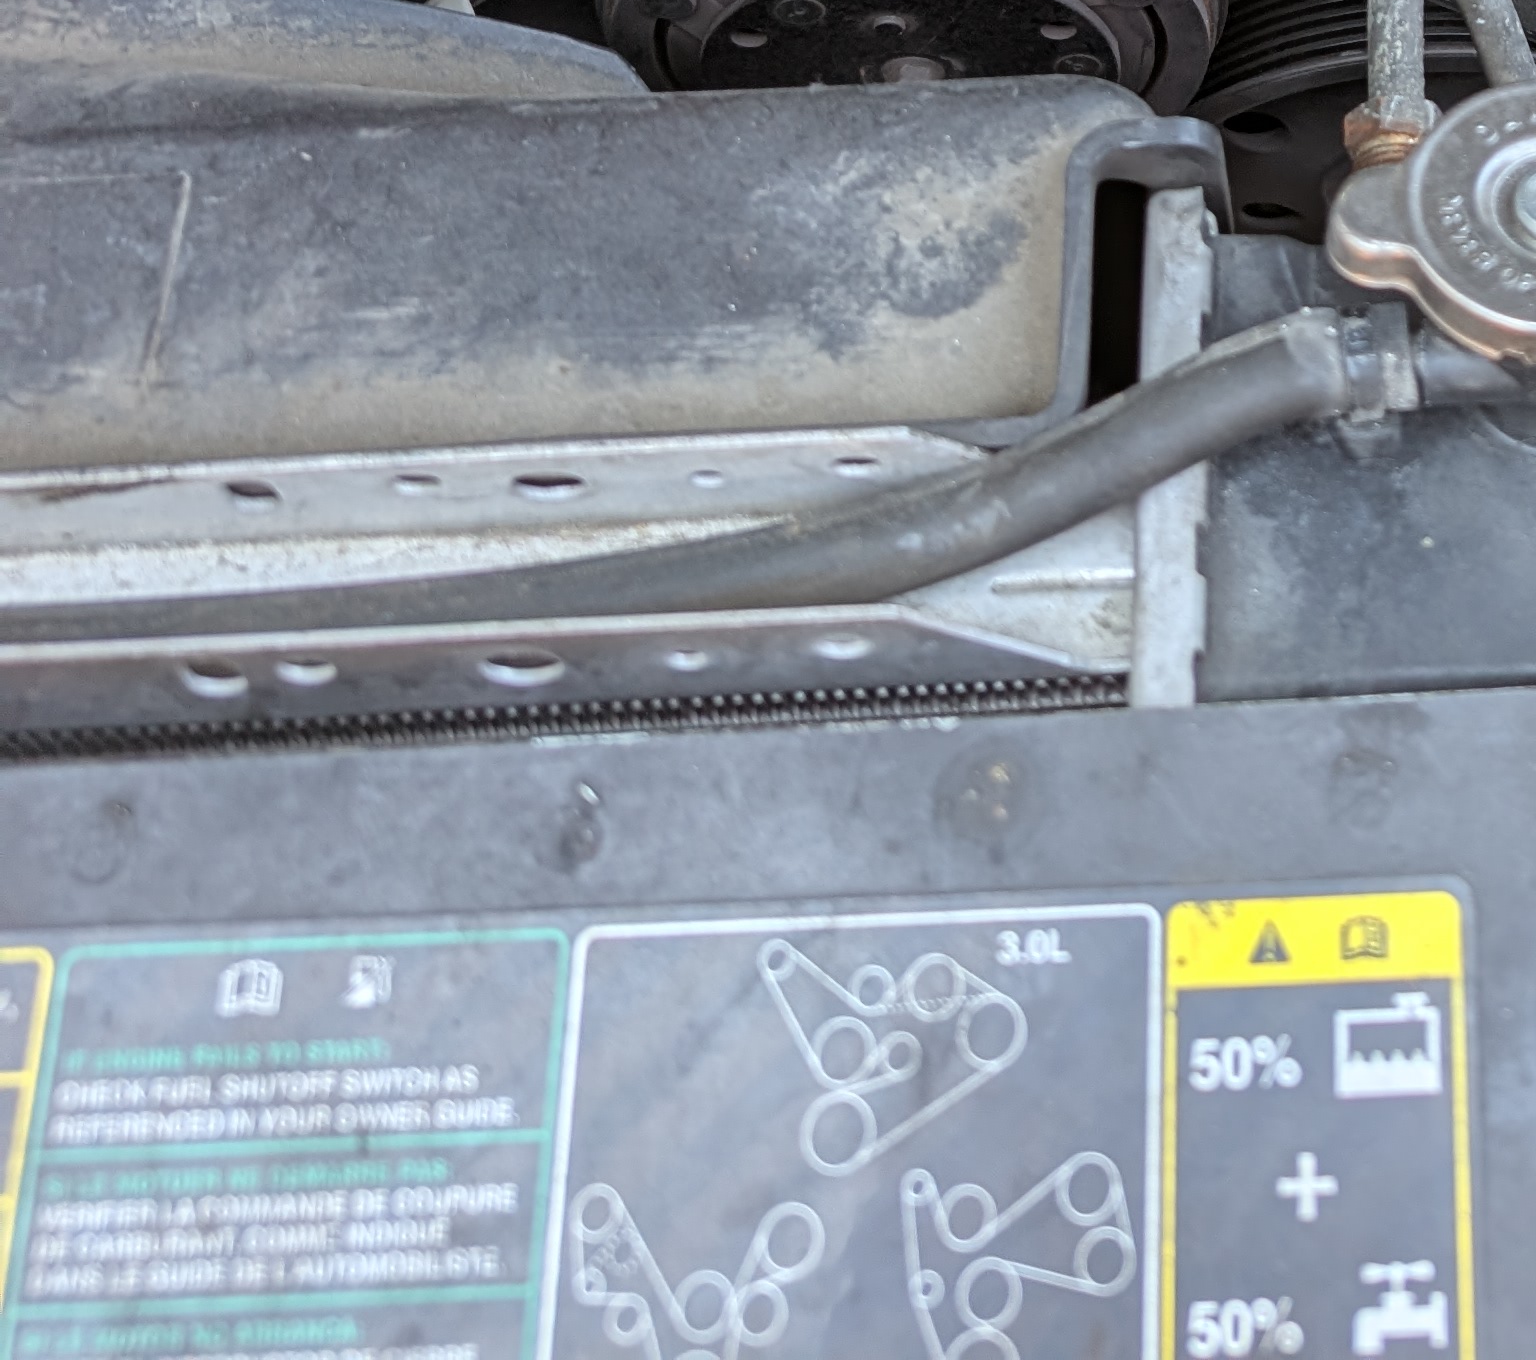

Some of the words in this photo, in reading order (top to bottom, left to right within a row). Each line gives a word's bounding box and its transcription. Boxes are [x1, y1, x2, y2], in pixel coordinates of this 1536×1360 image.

[996, 928, 1071, 968] 3.0L
[1188, 1035, 1303, 1091] 50%
[1186, 1297, 1305, 1357] 50%
